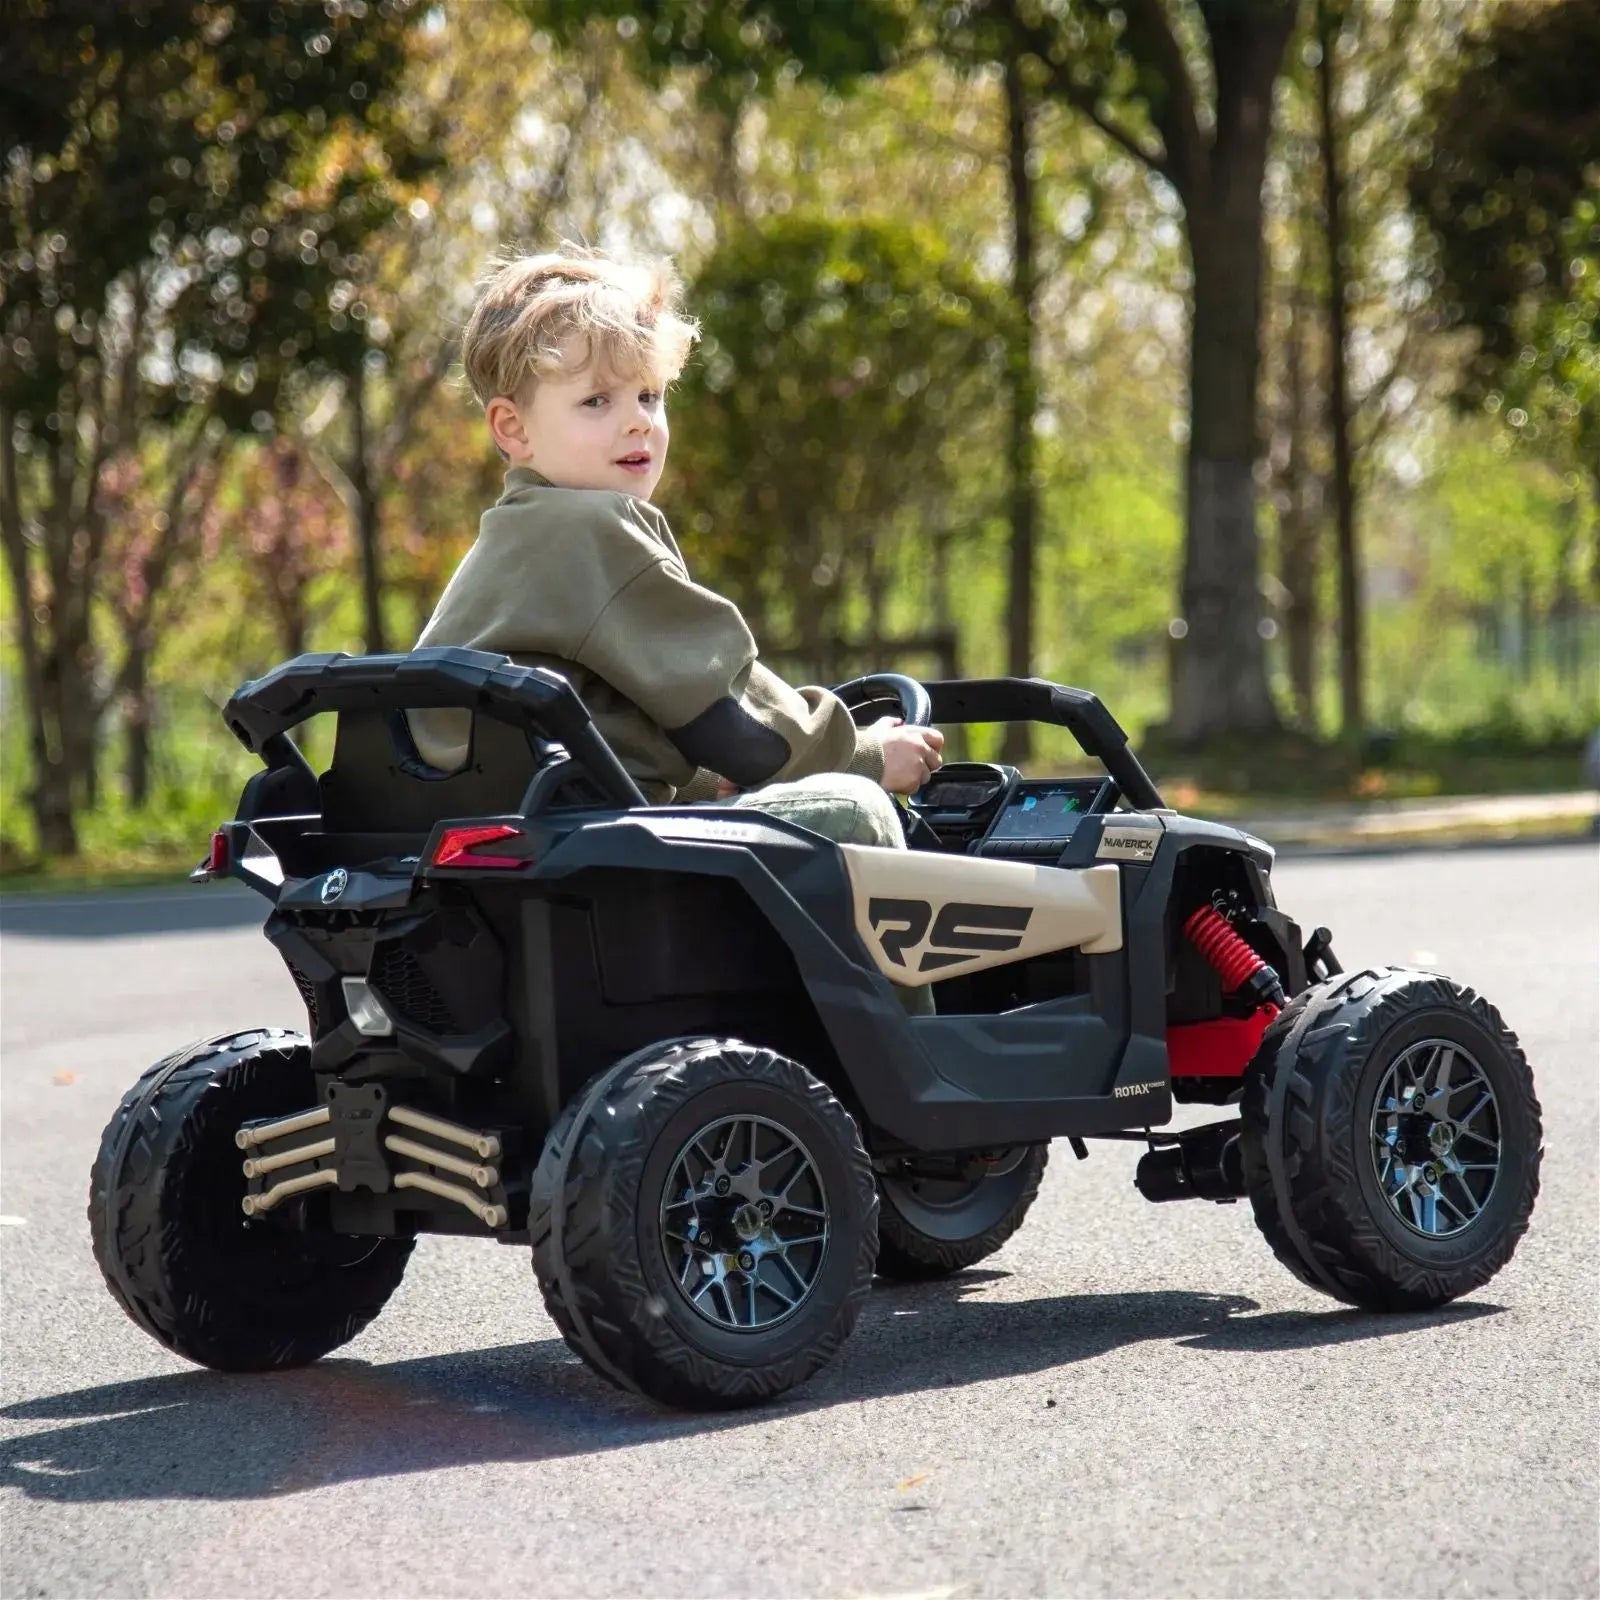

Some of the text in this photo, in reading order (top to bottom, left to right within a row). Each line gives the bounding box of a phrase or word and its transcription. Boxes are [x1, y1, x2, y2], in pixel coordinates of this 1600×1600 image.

[1104, 837, 1153, 850] MAVERICK
[868, 897, 1034, 972] RS
[1114, 1083, 1150, 1099] ROTAX
